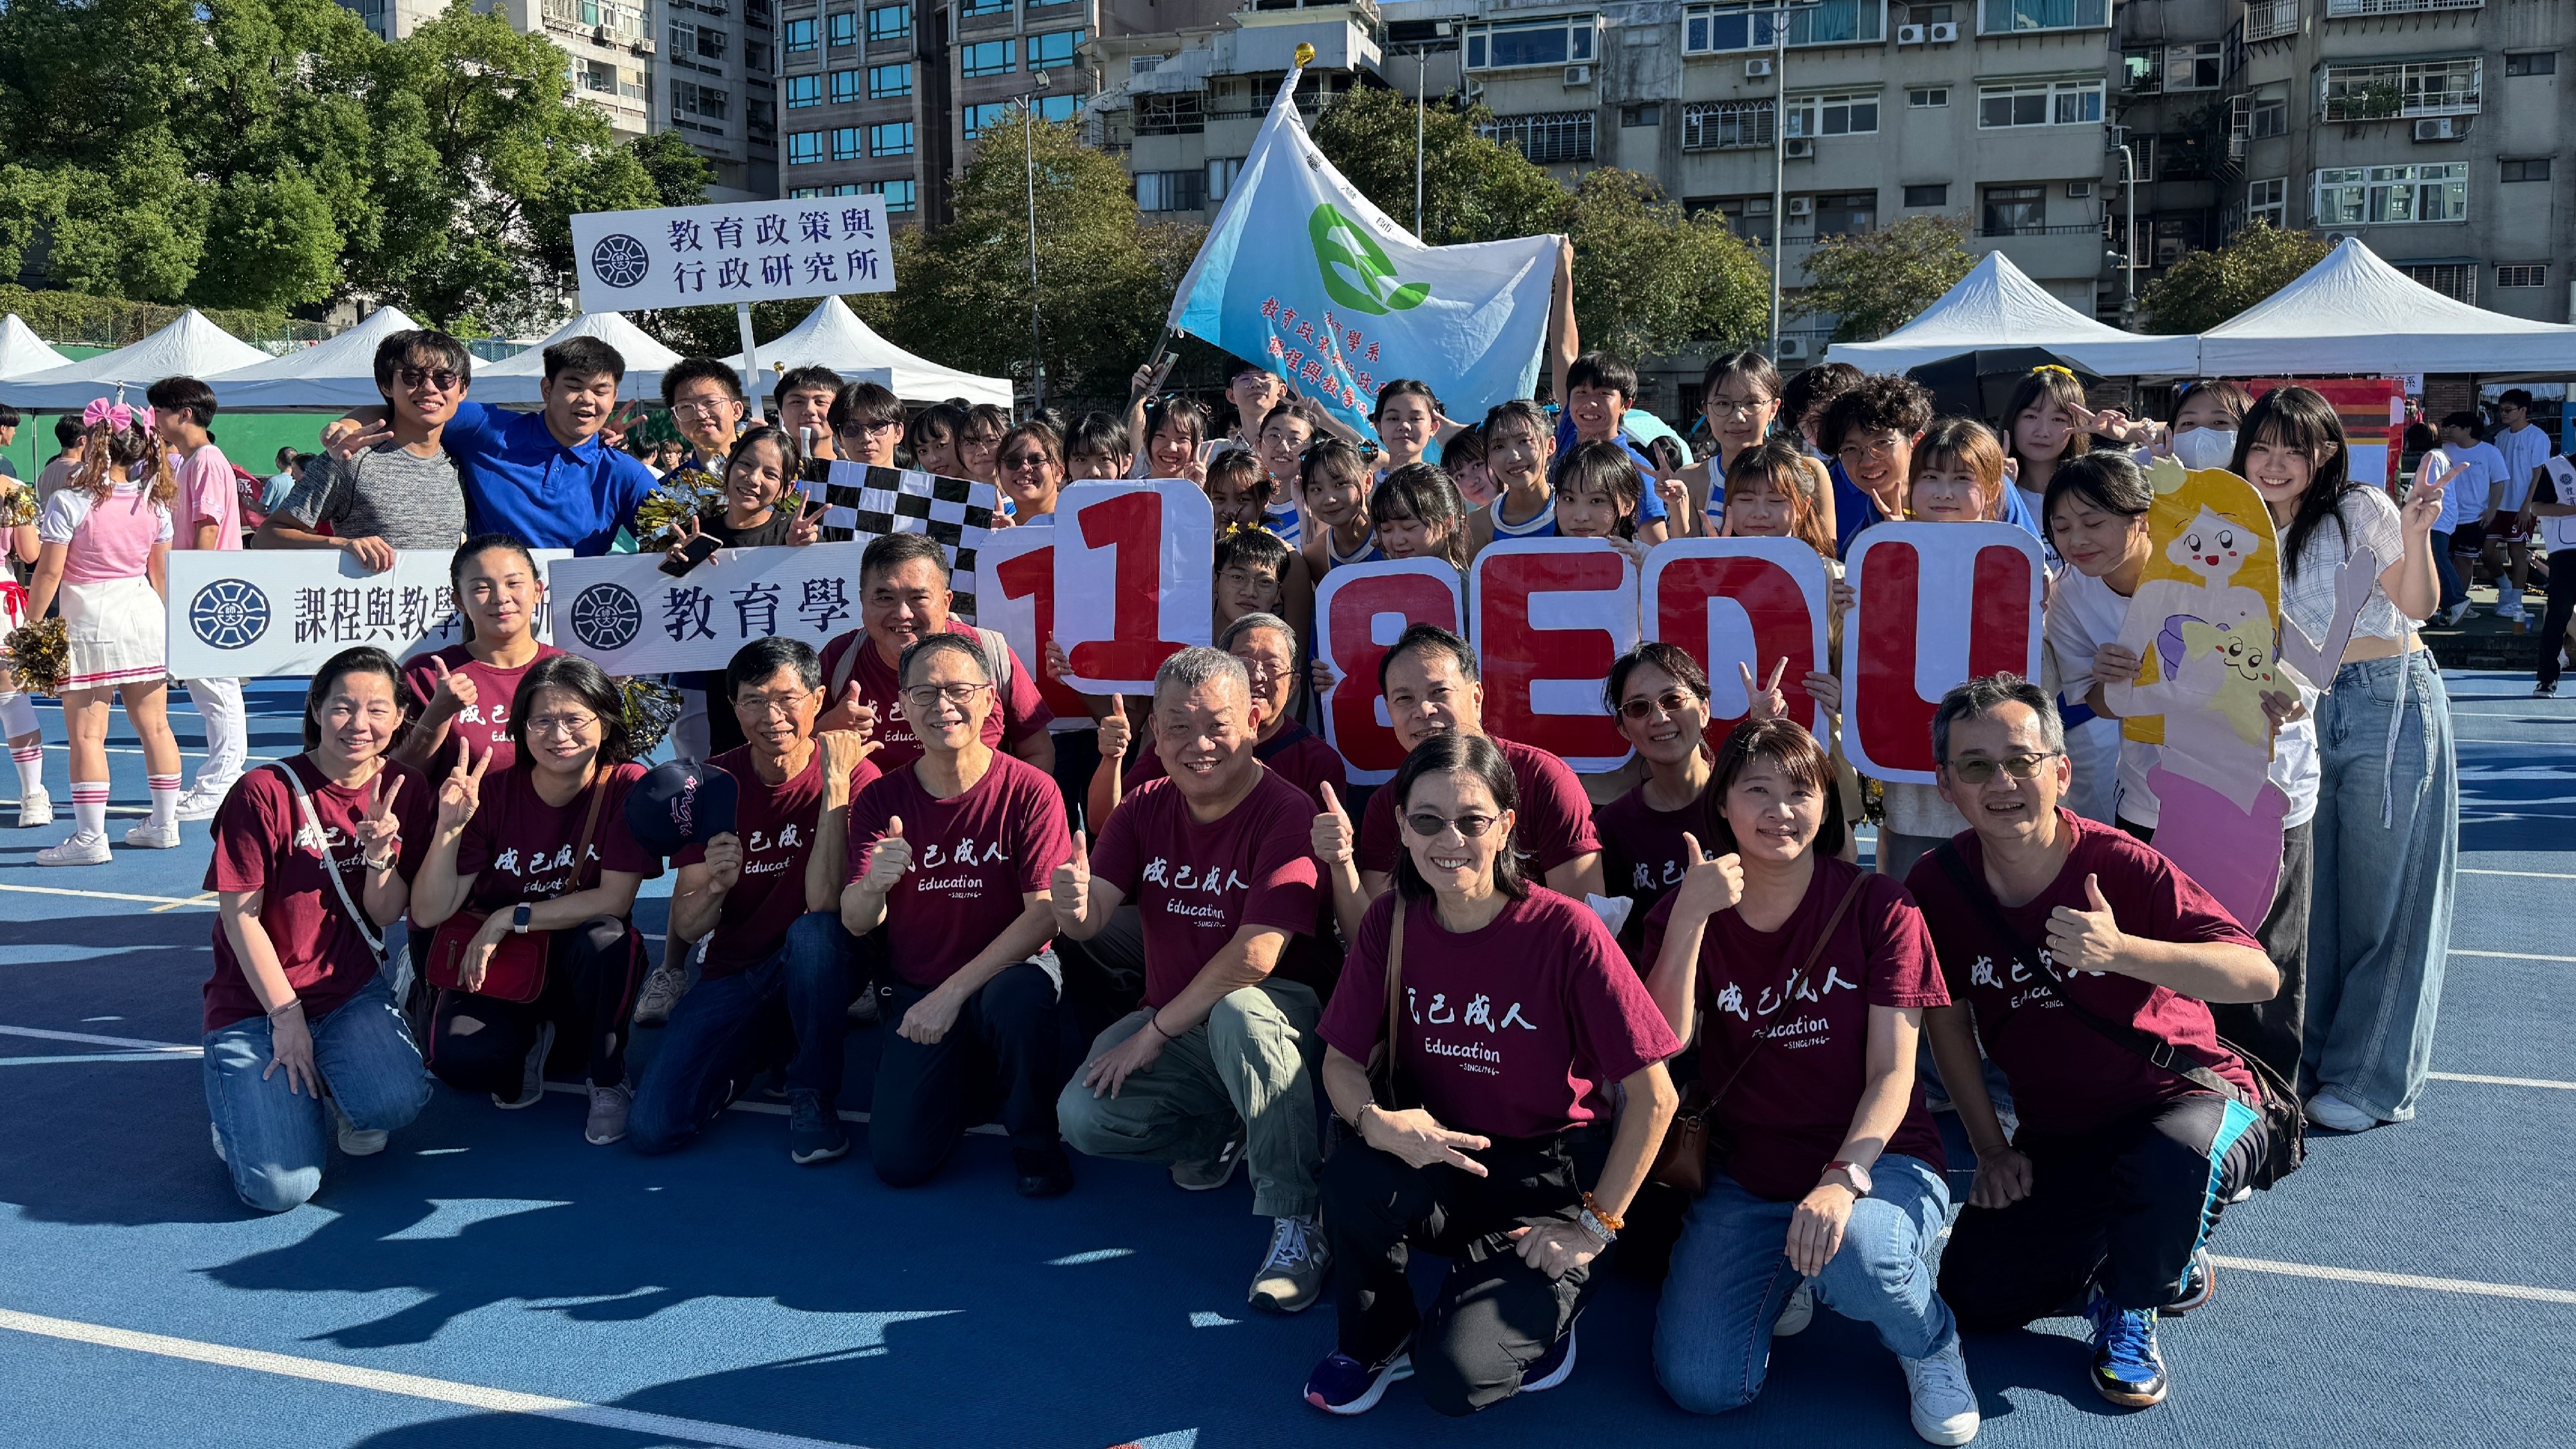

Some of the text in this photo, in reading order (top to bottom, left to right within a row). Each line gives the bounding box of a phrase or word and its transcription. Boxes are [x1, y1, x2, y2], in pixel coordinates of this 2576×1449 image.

[667, 208, 875, 253] 教育政策與
[672, 248, 878, 293] 行政研究所
[294, 585, 551, 643] 課程與教學
[662, 576, 850, 642] 教育學
[908, 837, 1009, 873] 己成人
[524, 876, 580, 893] Educati
[918, 875, 983, 891] Education
[1167, 898, 1225, 919] Education
[1425, 1037, 1501, 1063] Education
